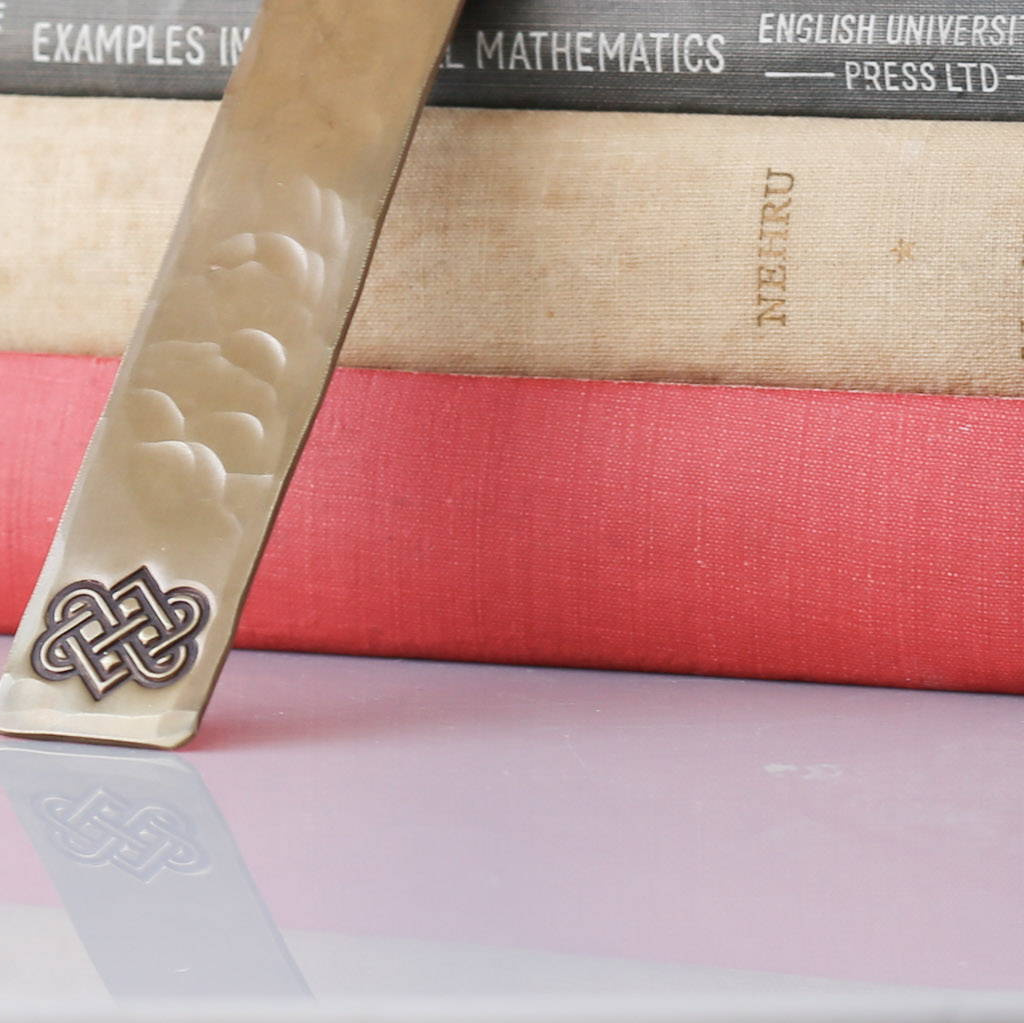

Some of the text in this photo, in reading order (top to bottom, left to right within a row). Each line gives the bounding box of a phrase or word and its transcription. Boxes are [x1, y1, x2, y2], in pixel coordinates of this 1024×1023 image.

[32, 22, 205, 67] EXAMPLES
[758, 12, 1024, 47] ENGLISH UNIVERSI
[478, 30, 726, 74] MATHEMATICS
[844, 60, 999, 93] PRESS LTD
[756, 167, 795, 327] NEHRU
